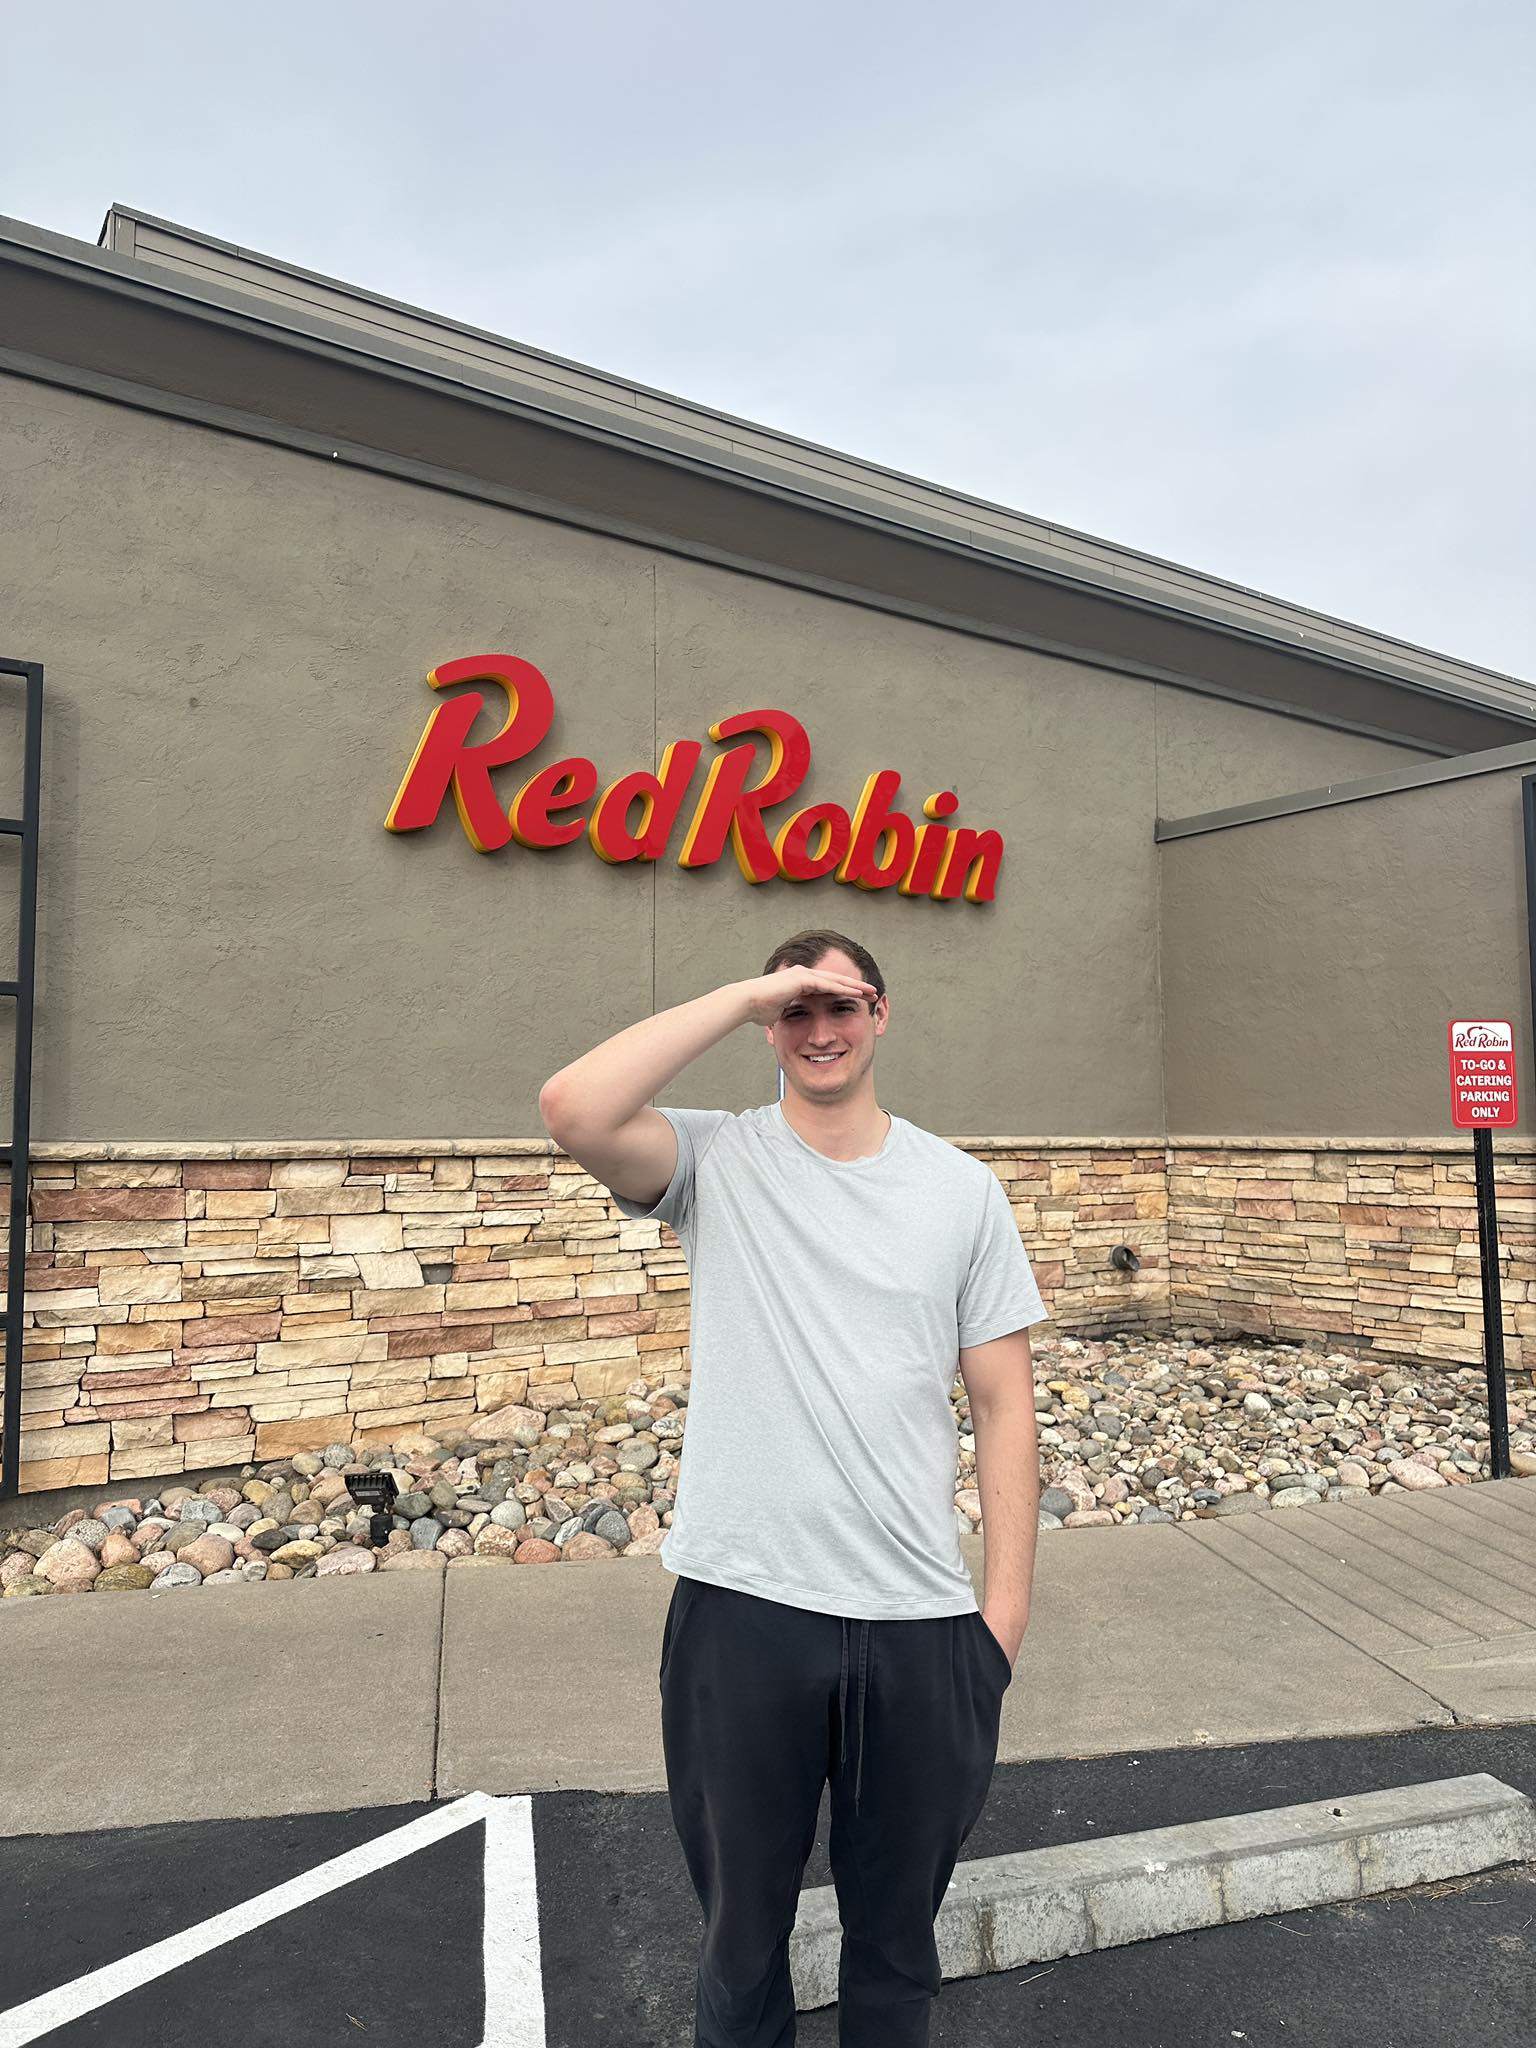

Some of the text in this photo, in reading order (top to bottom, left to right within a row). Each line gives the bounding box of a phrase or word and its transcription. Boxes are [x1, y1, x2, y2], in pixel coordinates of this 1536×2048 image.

[1455, 1033, 1509, 1048] Red Robin
[1460, 1059, 1507, 1070] TO-GO &
[1456, 1075, 1512, 1086] CATERING
[1460, 1091, 1510, 1102] PARKING
[1471, 1106, 1500, 1118] ONLY
